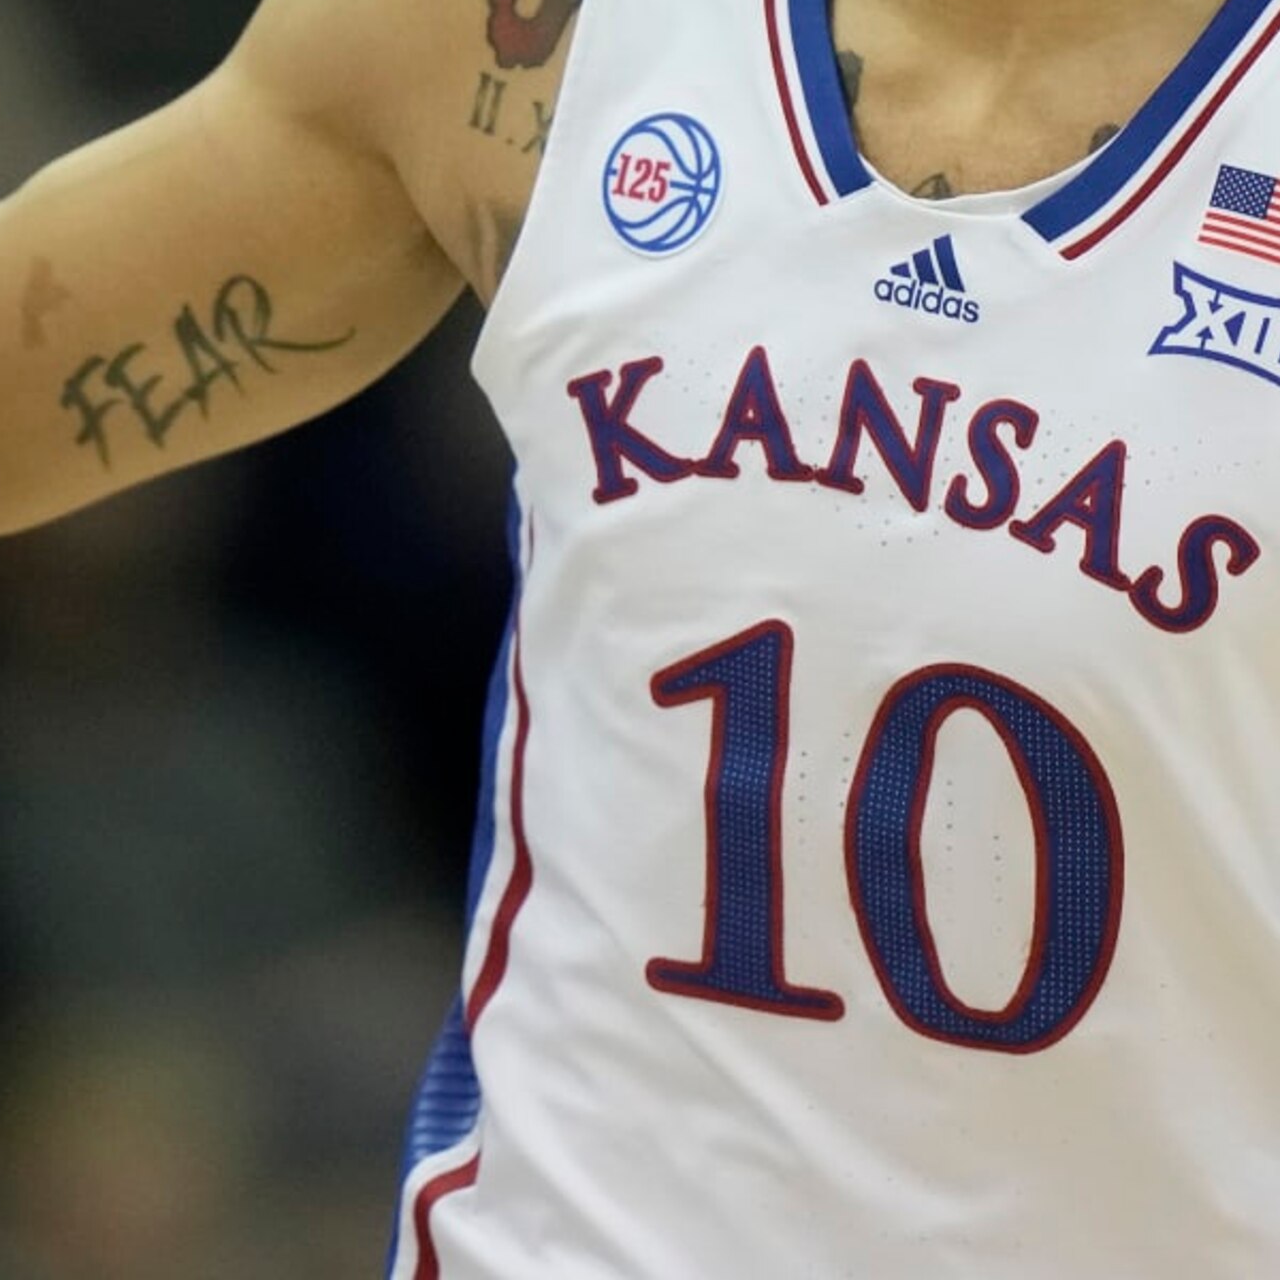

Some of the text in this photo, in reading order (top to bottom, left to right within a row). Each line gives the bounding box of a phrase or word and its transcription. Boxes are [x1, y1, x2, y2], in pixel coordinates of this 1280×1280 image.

[612, 153, 671, 203] 125
[61, 274, 356, 468] FEAR
[874, 278, 979, 323] adidas
[567, 345, 1260, 633] KANSAS
[645, 618, 1125, 1055] 10
